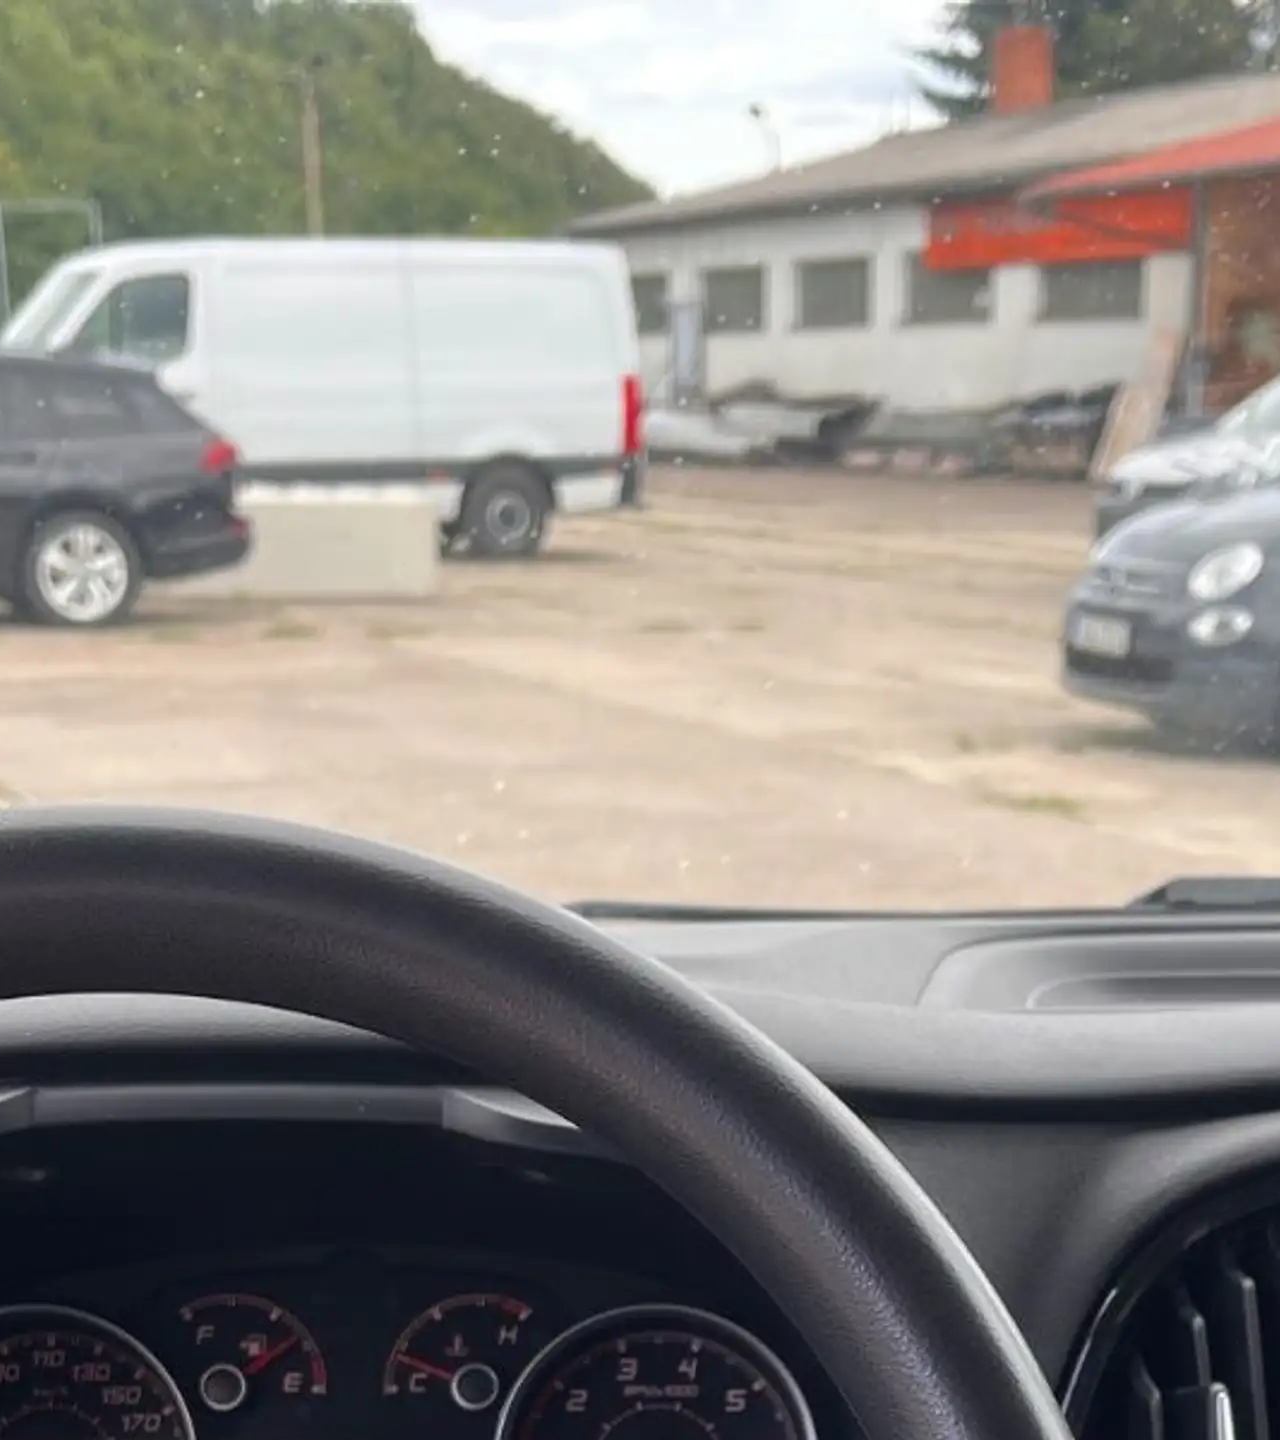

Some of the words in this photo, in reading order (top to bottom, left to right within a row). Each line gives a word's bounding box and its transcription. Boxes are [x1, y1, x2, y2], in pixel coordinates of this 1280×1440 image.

[196, 1325, 214, 1344] F
[497, 1326, 517, 1345] H
[617, 1358, 637, 1380] 3
[677, 1358, 697, 1381] 4
[283, 1372, 304, 1393] E
[409, 1373, 426, 1393] C
[565, 1390, 588, 1412] 2
[725, 1389, 747, 1412] 5
